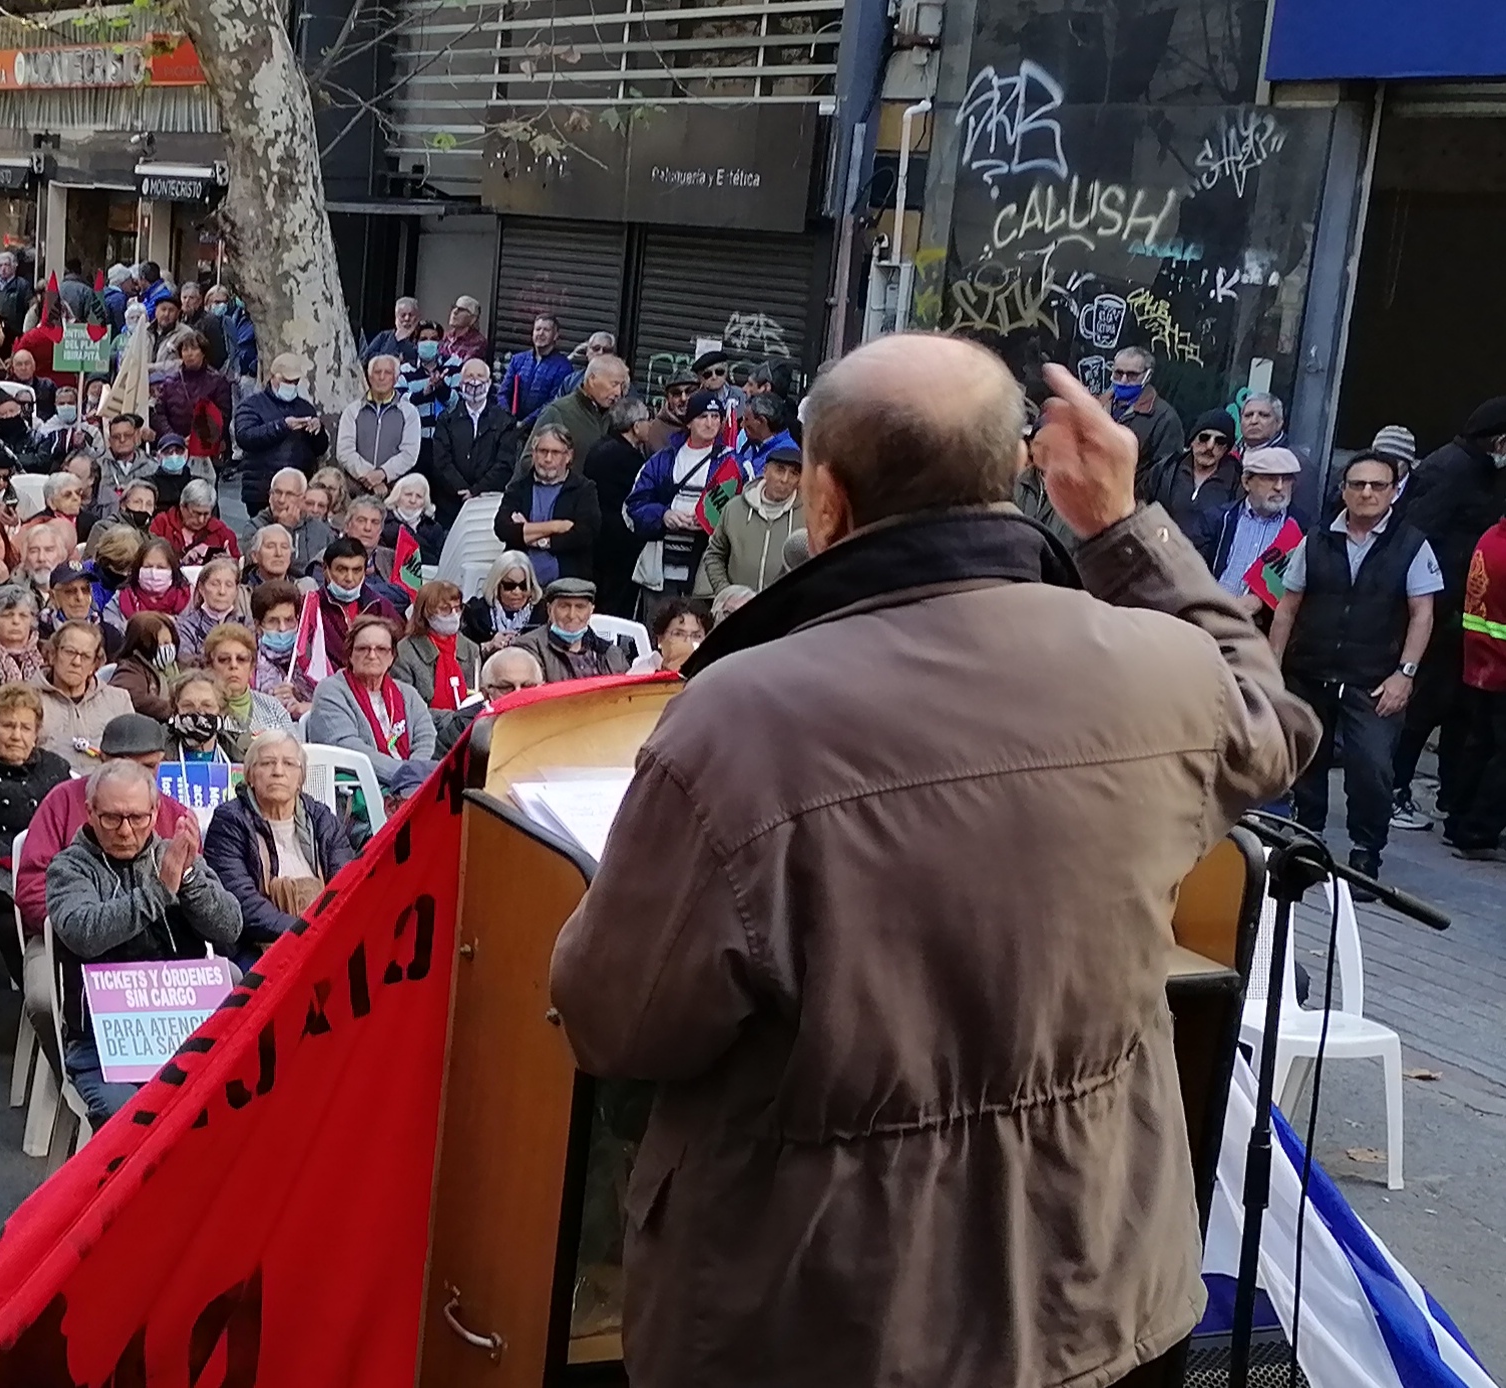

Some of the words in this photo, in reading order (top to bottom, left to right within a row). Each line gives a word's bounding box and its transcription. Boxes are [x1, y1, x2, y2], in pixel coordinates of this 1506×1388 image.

[150, 177, 202, 197] MONTECRISTO
[995, 173, 1176, 249] CALUSH
[65, 340, 78, 349] DEL
[91, 969, 148, 990] TICKETS
[149, 969, 160, 987] Y
[162, 965, 224, 988] ÓRDENES
[125, 990, 150, 1008] SIN
[151, 987, 197, 1007] CARGO
[102, 1018, 145, 1038] PARA
[150, 1011, 214, 1037] ATENCI
[106, 1037, 129, 1057] DE
[135, 1038, 154, 1056] LA
